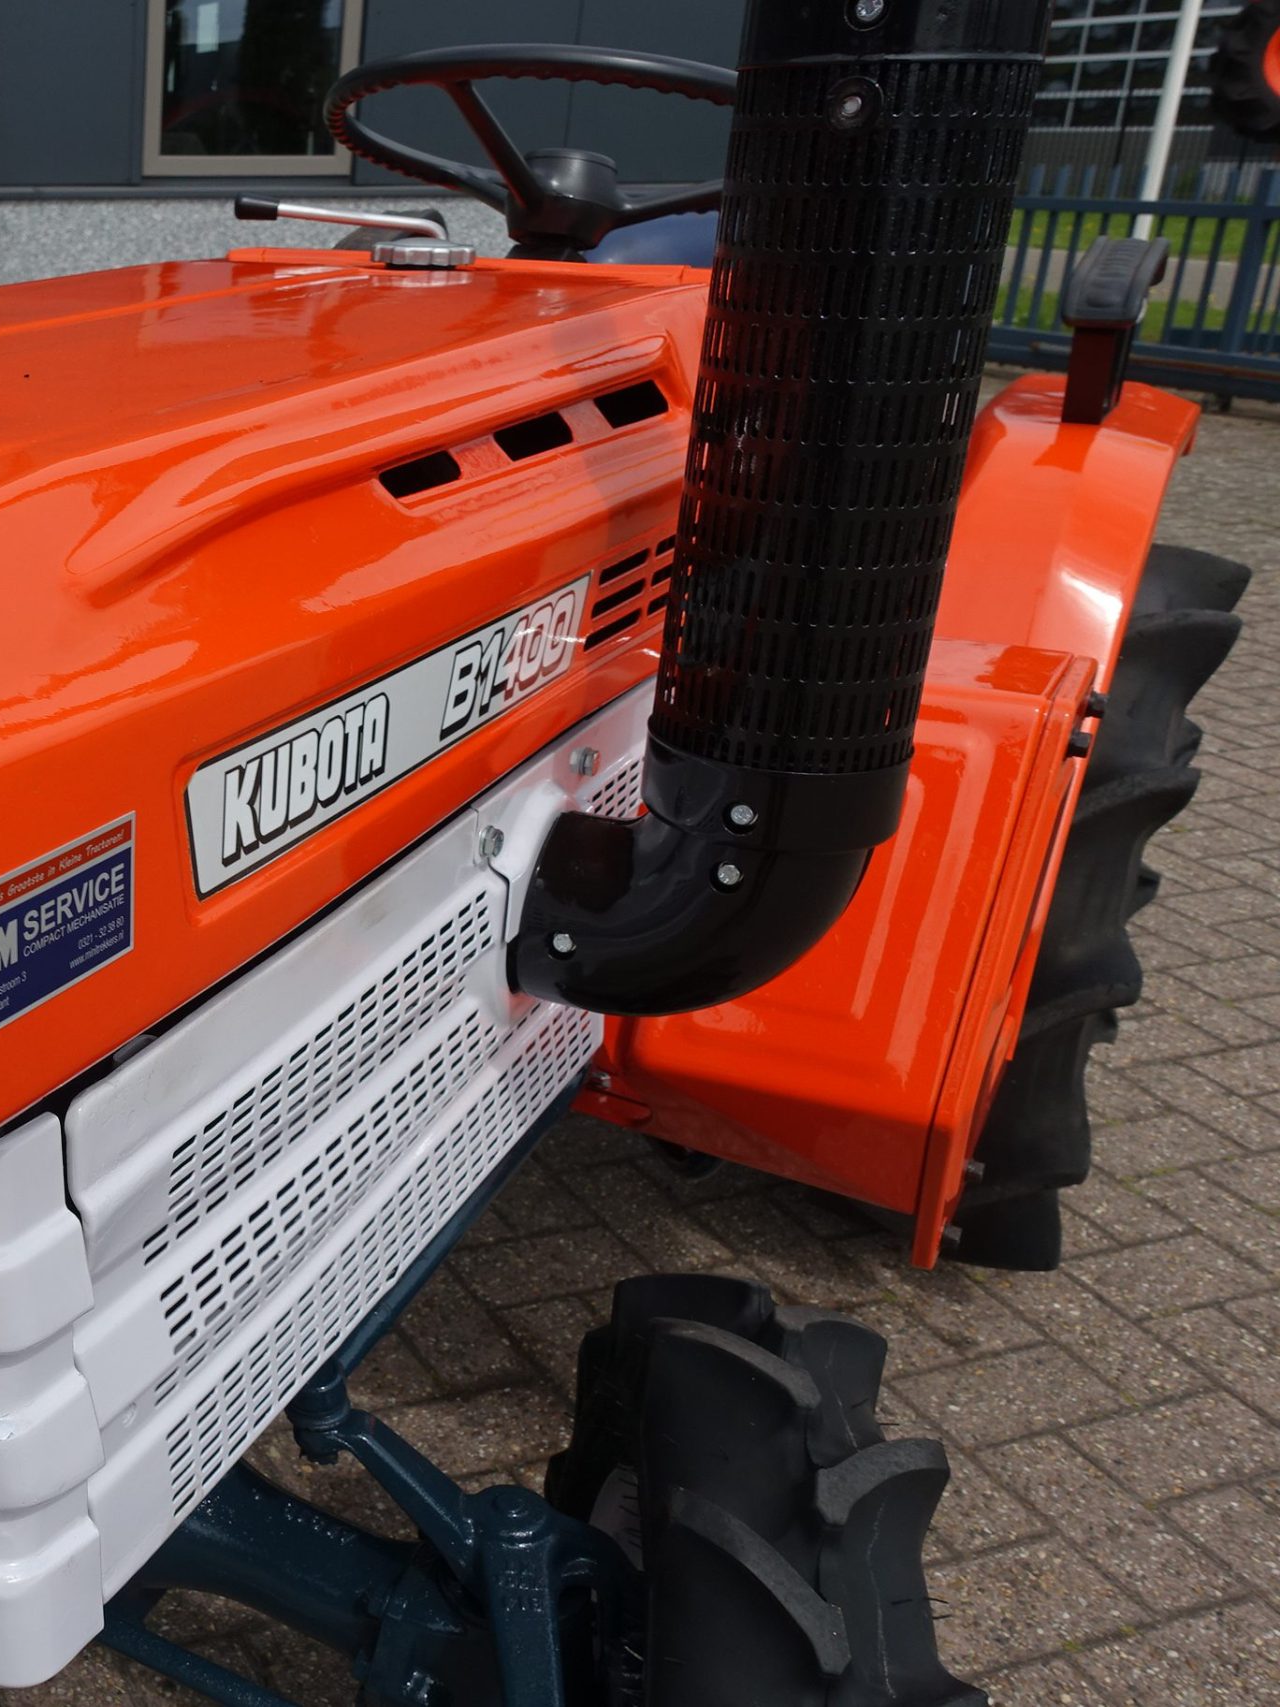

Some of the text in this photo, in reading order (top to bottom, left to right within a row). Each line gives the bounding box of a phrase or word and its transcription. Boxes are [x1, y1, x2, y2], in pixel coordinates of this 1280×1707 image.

[222, 589, 577, 867] KUBOTA B1400
[7, 872, 45, 898] Grootste
[47, 865, 56, 877] in
[58, 853, 82, 872] Kleine
[23, 863, 125, 941] SERVICE
[23, 893, 125, 957] COMPACT MECHANISATIE
